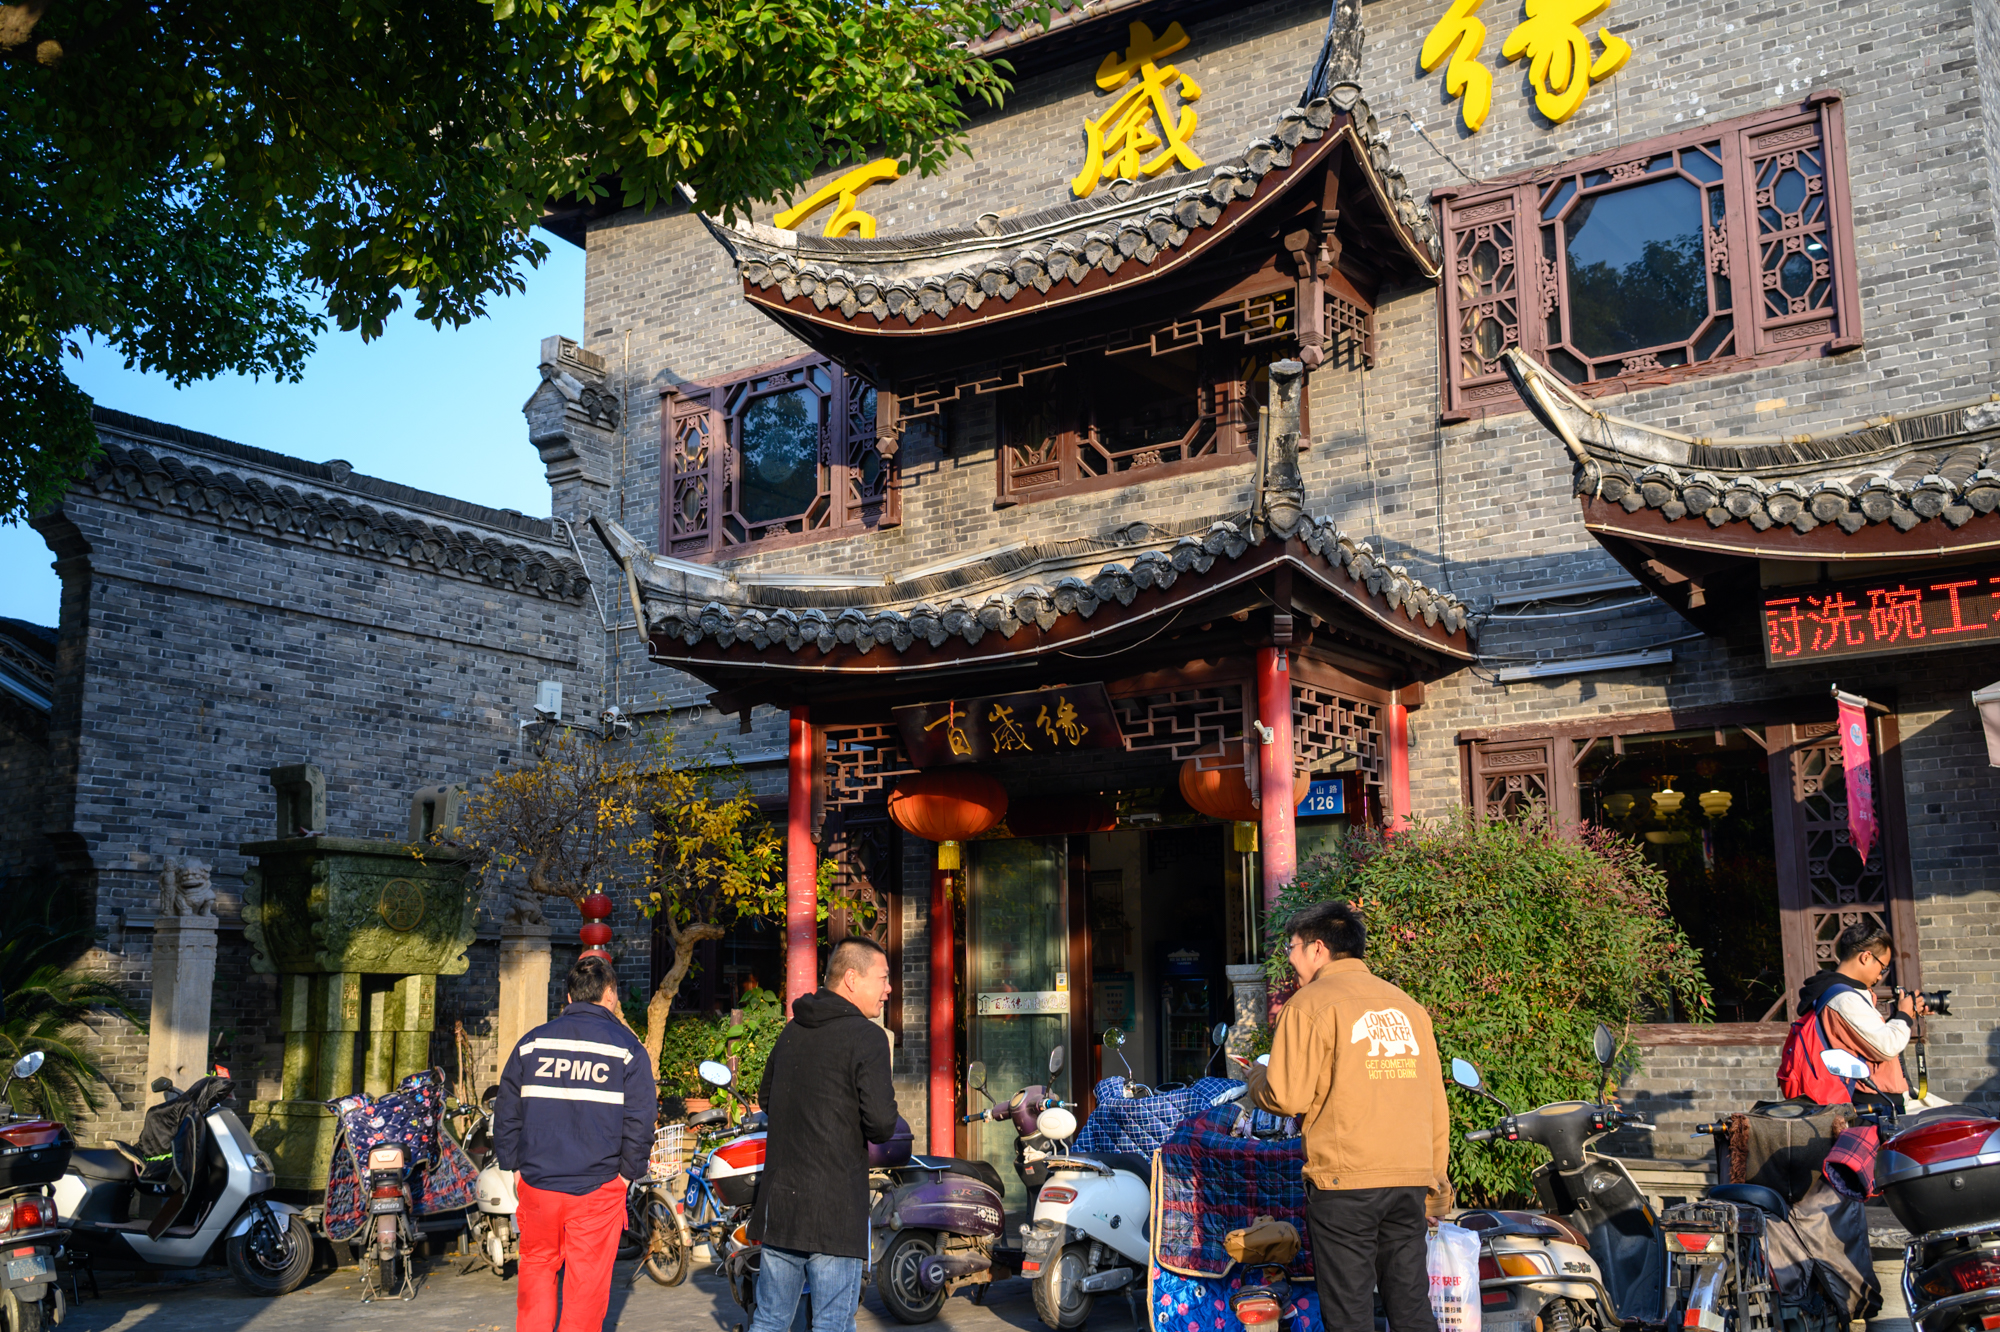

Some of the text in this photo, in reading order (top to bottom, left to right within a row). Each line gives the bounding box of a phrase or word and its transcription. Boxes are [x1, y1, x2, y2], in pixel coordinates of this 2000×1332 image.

[1765, 576, 2000, 656] 厨洗碗工
[1308, 785, 1338, 795] 山路
[1308, 796, 1335, 811] 126
[1364, 1012, 1407, 1027] LONELY
[1368, 1027, 1412, 1041] WALKER
[534, 1057, 610, 1084] ZPMC
[1365, 1060, 1379, 1069] GET
[1368, 1069, 1418, 1080] HOT TO DRINK
[1428, 1275, 1462, 1286] 文快印
